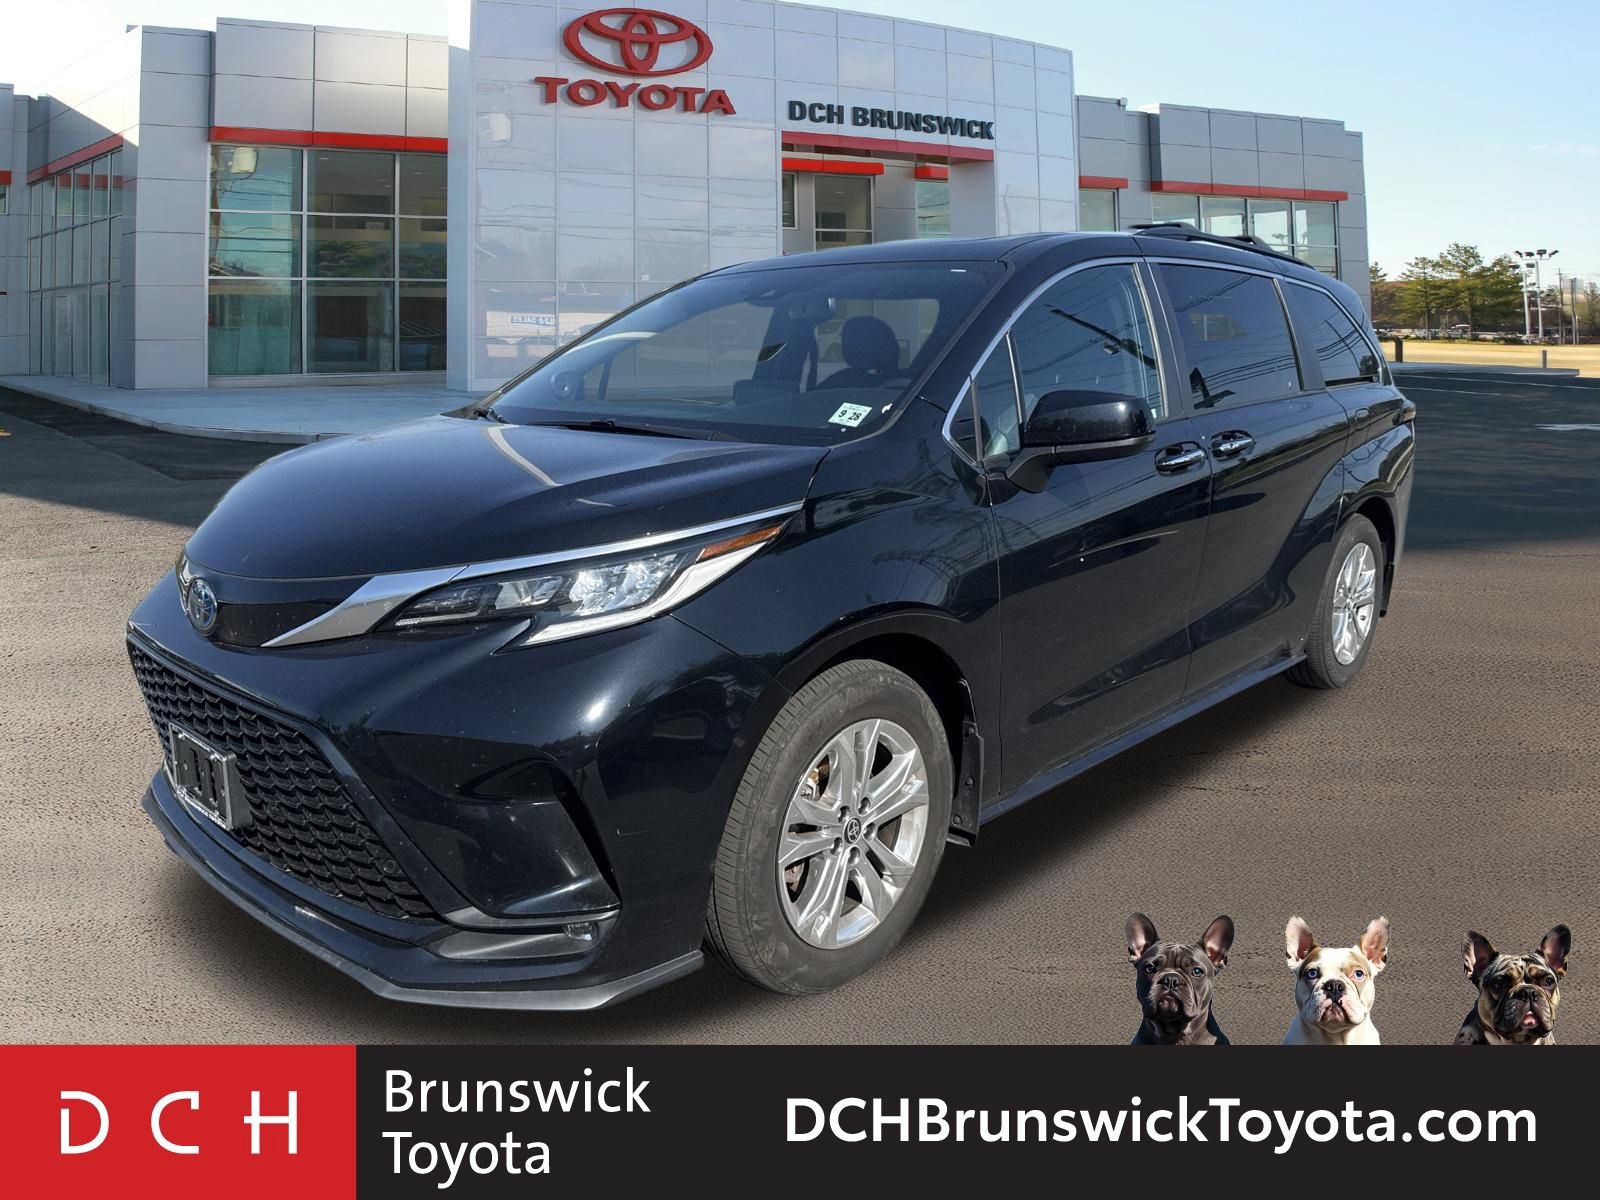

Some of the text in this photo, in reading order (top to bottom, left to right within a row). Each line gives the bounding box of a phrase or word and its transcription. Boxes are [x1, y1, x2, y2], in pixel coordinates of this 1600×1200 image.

[535, 76, 736, 115] TOYOTA
[788, 100, 995, 140] DCH BRUNSWICK
[838, 410, 847, 418] 9
